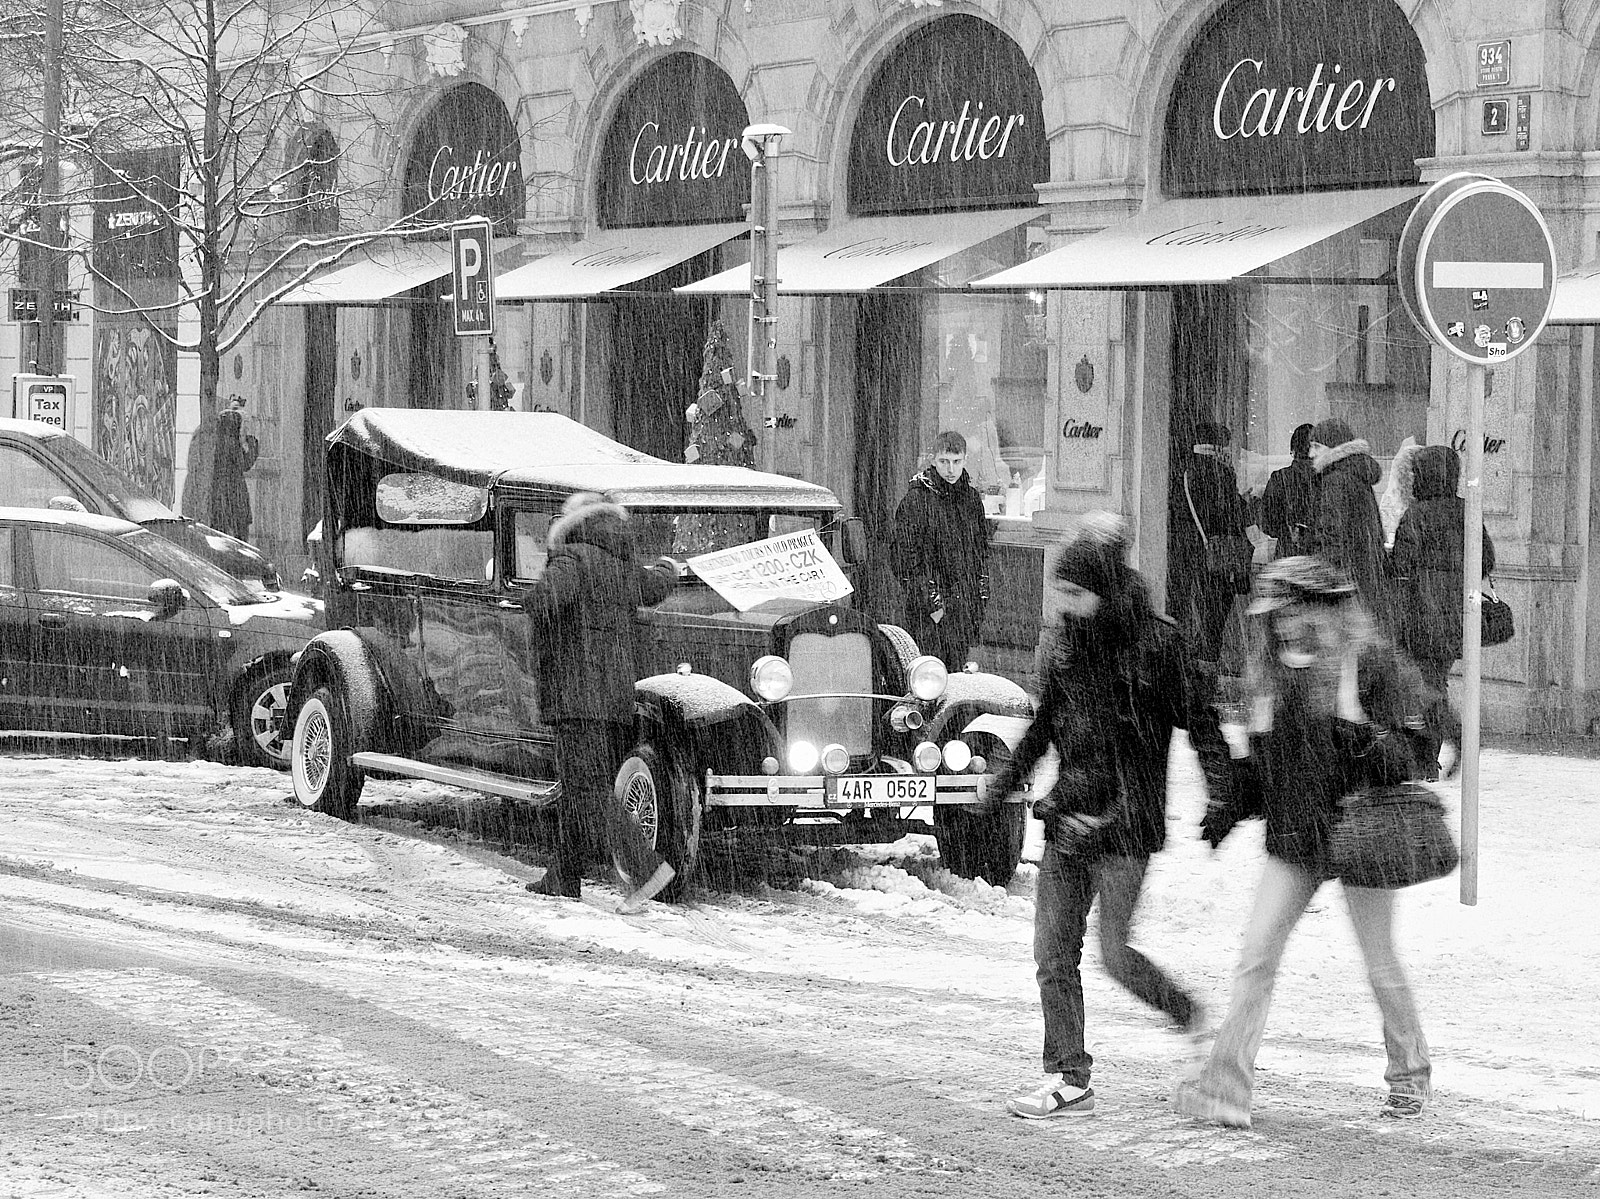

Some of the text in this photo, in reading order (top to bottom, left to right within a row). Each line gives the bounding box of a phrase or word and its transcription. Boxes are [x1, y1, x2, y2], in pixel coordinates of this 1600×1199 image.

[1481, 47, 1503, 66] 934
[1213, 58, 1395, 140] Cartier
[1490, 107, 1498, 126] 2
[886, 95, 1025, 167] Cartier
[629, 122, 738, 185] Cartier
[428, 146, 516, 202] Cartier
[460, 238, 482, 301] P
[14, 301, 71, 311] ZETH
[1488, 347, 1506, 356] Sho
[34, 398, 60, 410] Tax
[33, 413, 61, 426] Free
[772, 539, 788, 555] OLD
[789, 548, 825, 570] CZK
[842, 779, 927, 800] 4AR 0562
